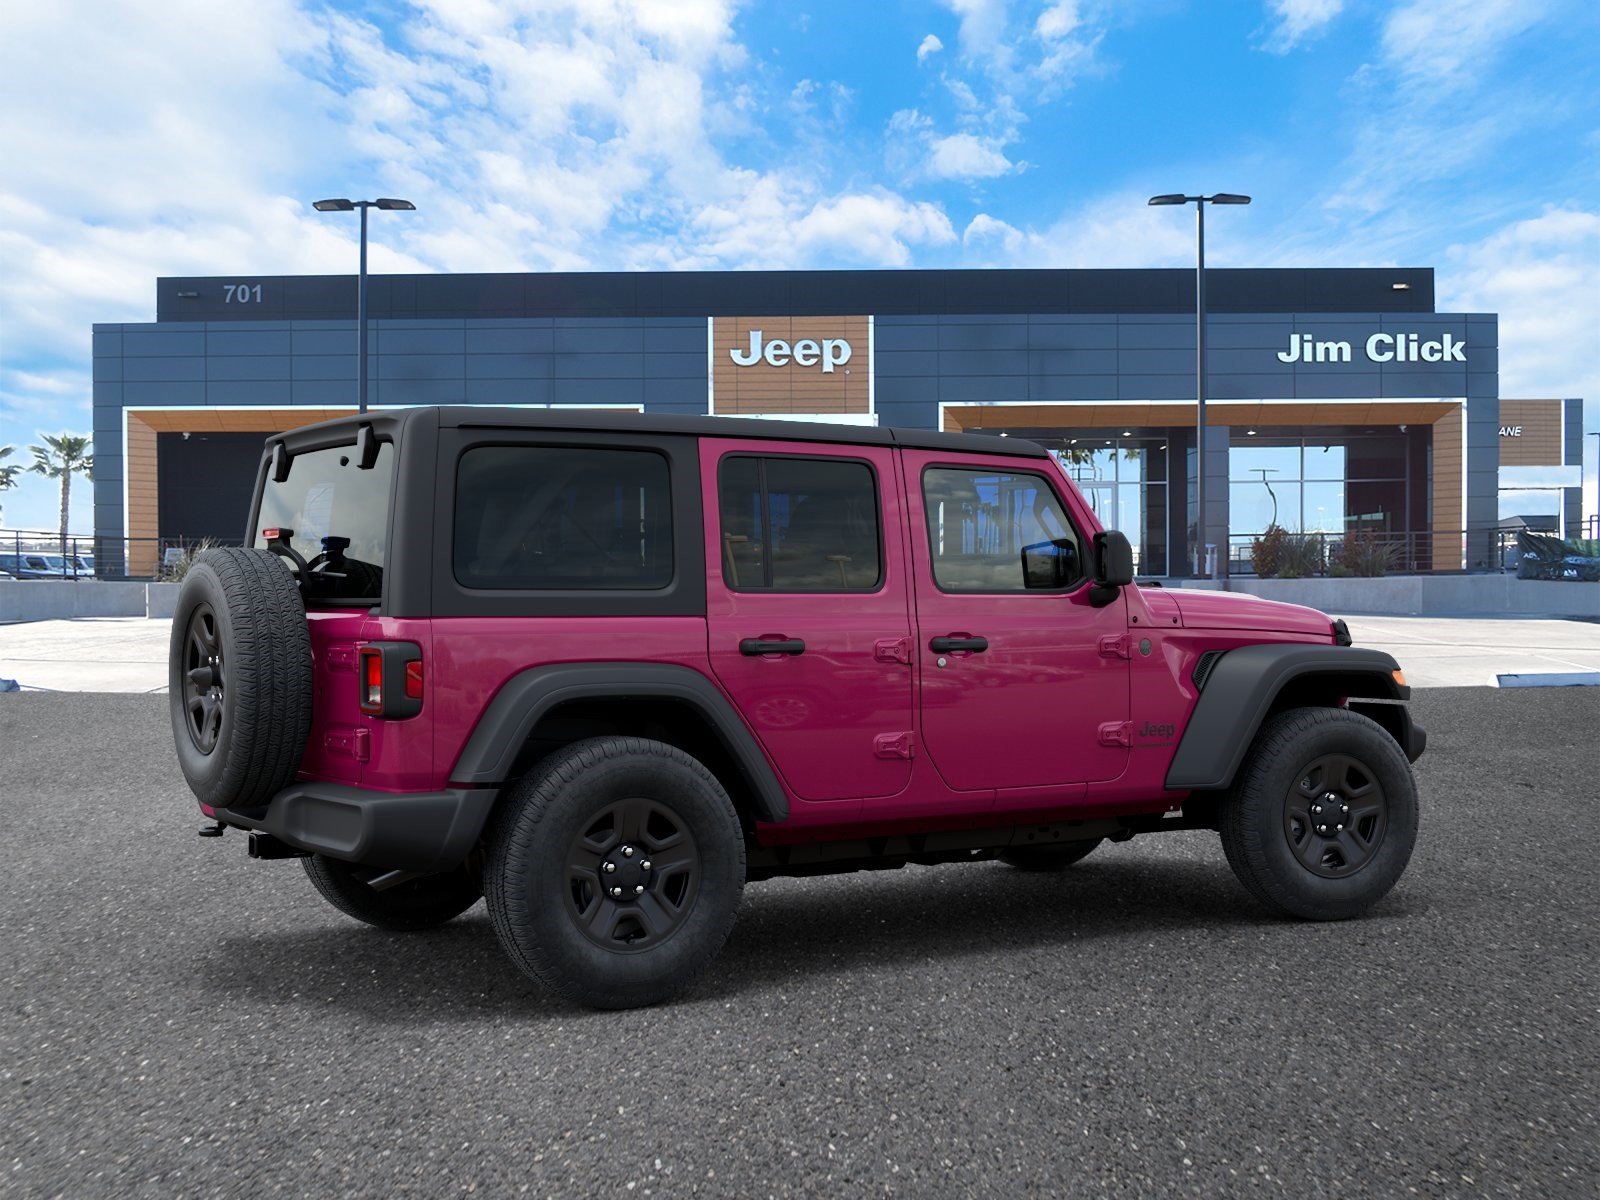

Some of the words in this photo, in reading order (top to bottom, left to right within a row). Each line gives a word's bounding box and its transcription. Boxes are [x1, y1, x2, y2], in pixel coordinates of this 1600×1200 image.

[223, 284, 262, 303] 701
[729, 330, 852, 373] Jeep
[1277, 333, 1351, 363] Jim
[1365, 332, 1467, 363] Click
[1498, 426, 1522, 437] ANE
[1139, 720, 1175, 740] Jeep
